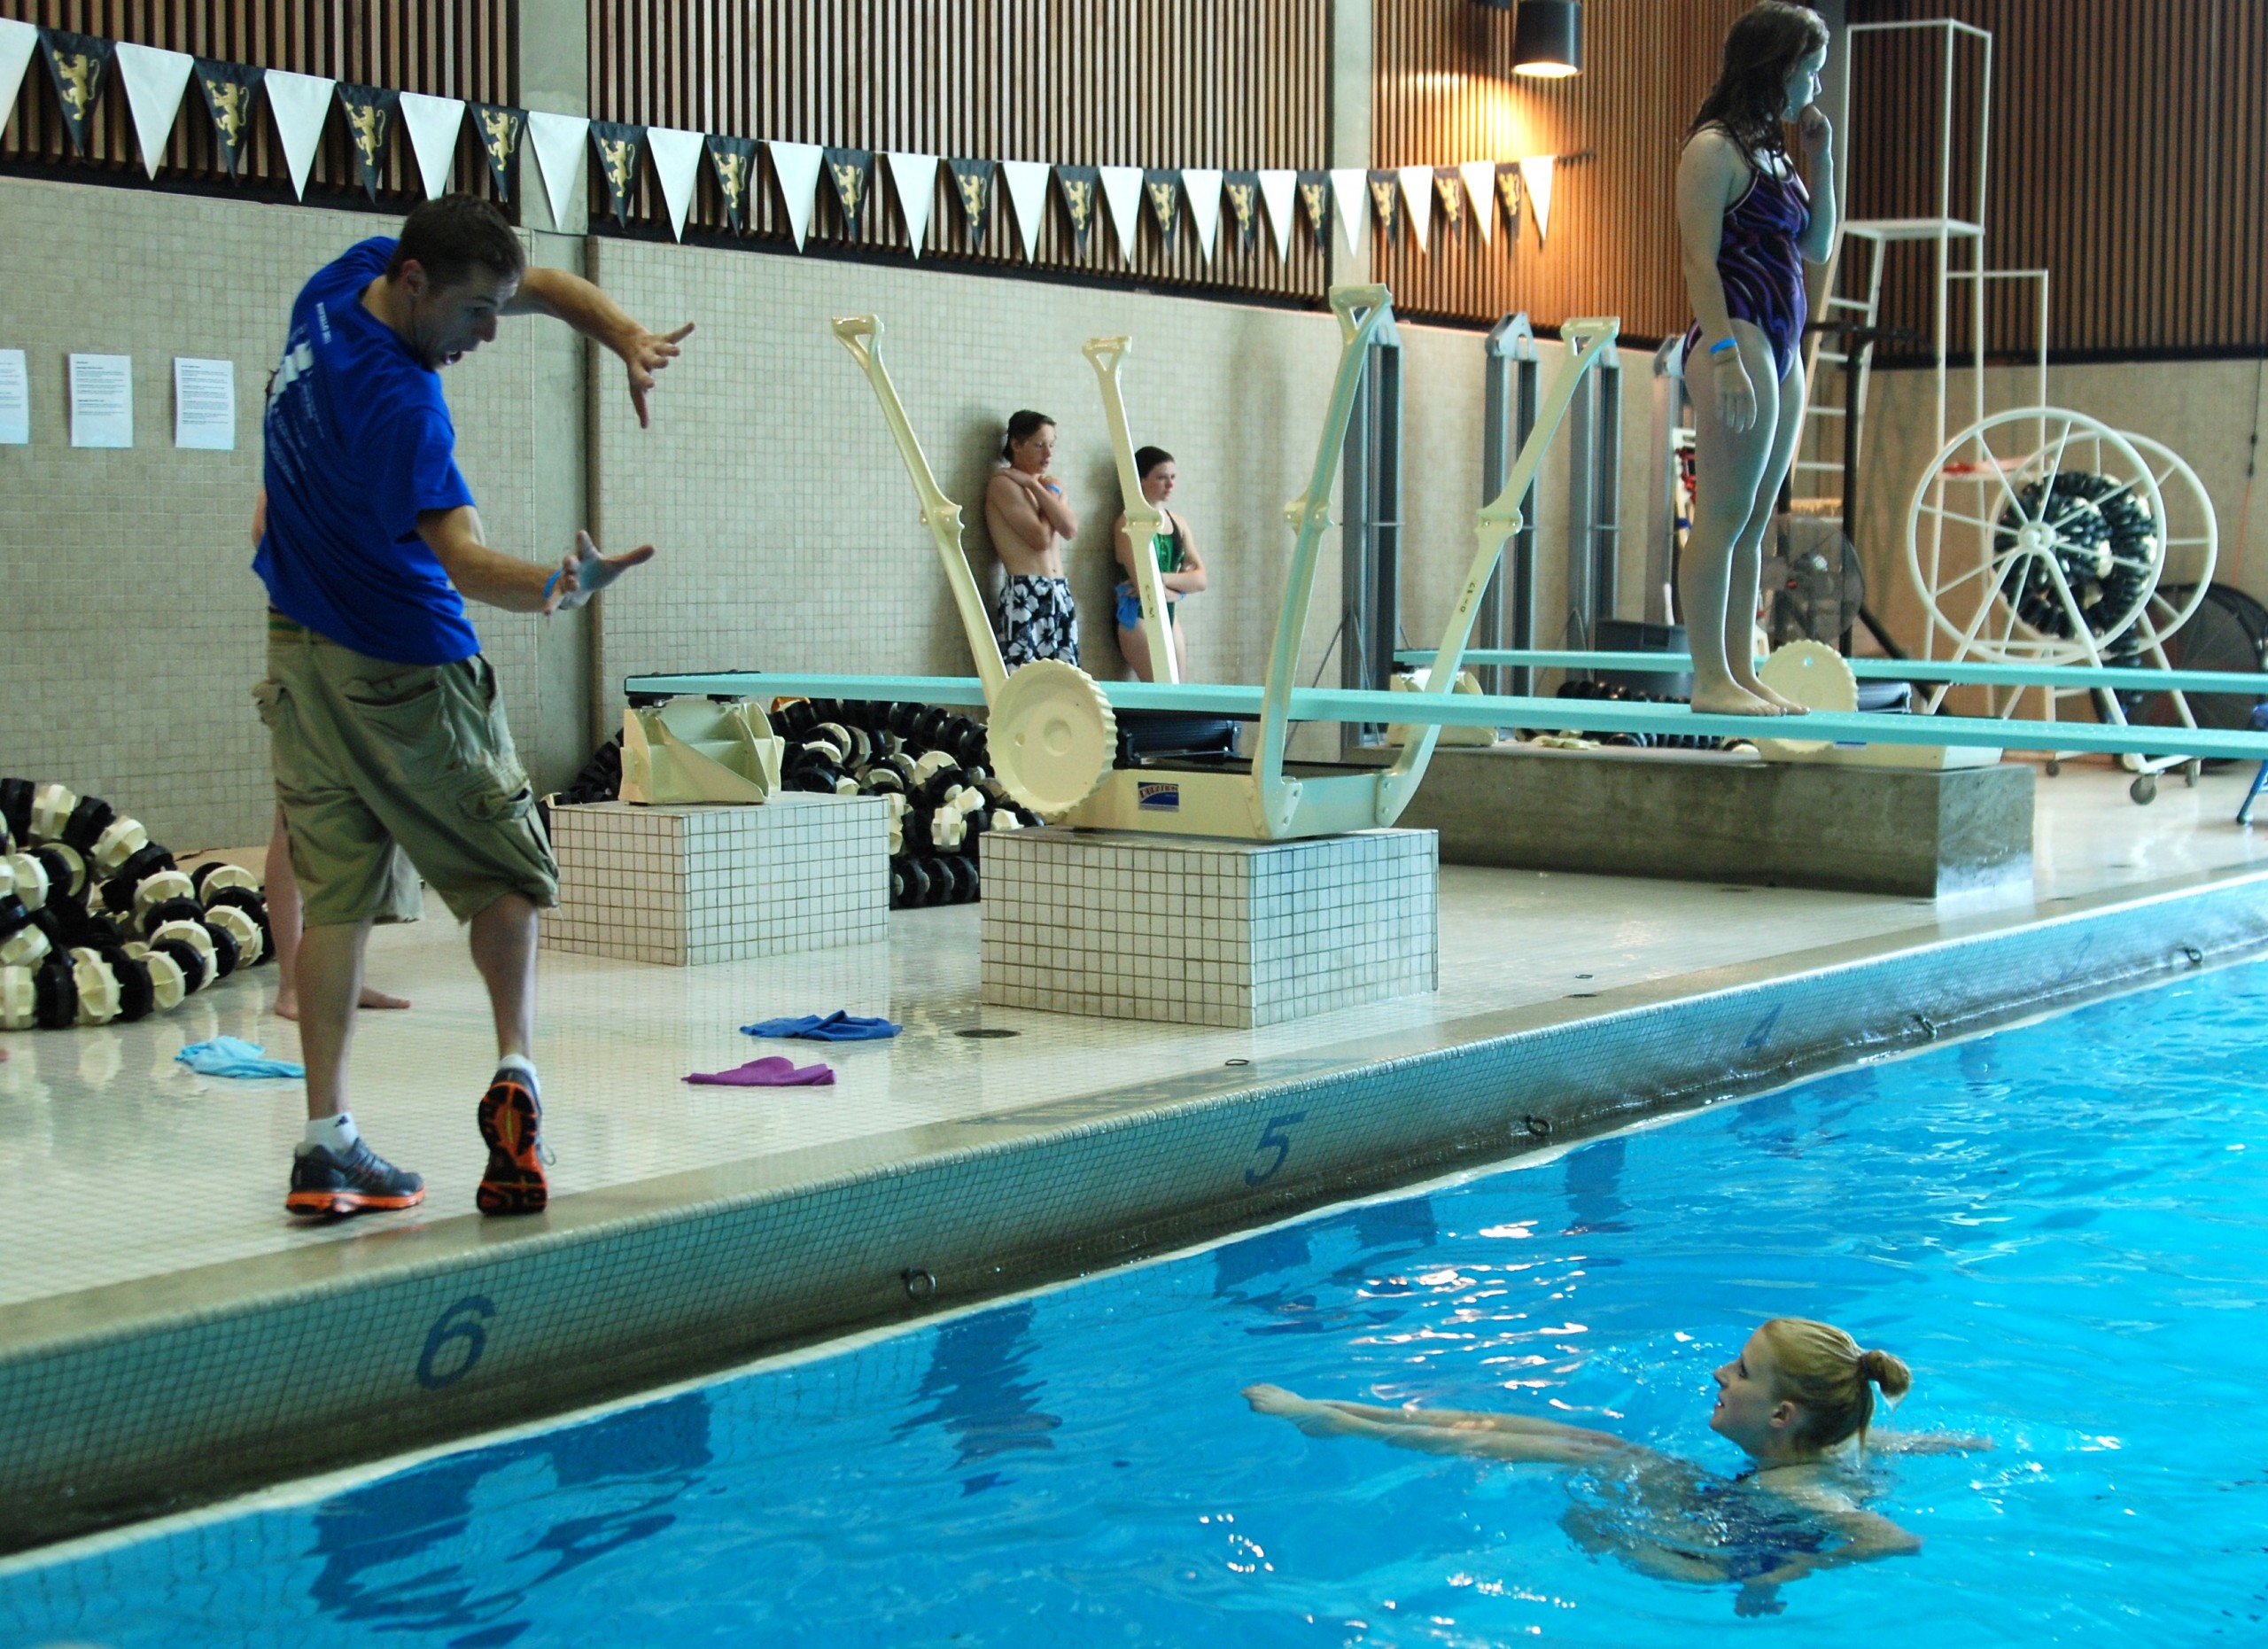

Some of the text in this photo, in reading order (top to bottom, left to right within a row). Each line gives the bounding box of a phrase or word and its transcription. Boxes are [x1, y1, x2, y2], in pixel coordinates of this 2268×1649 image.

[1740, 1003, 1783, 1053] 4
[1245, 1110, 1308, 1187] 5
[416, 1294, 496, 1390] 6
